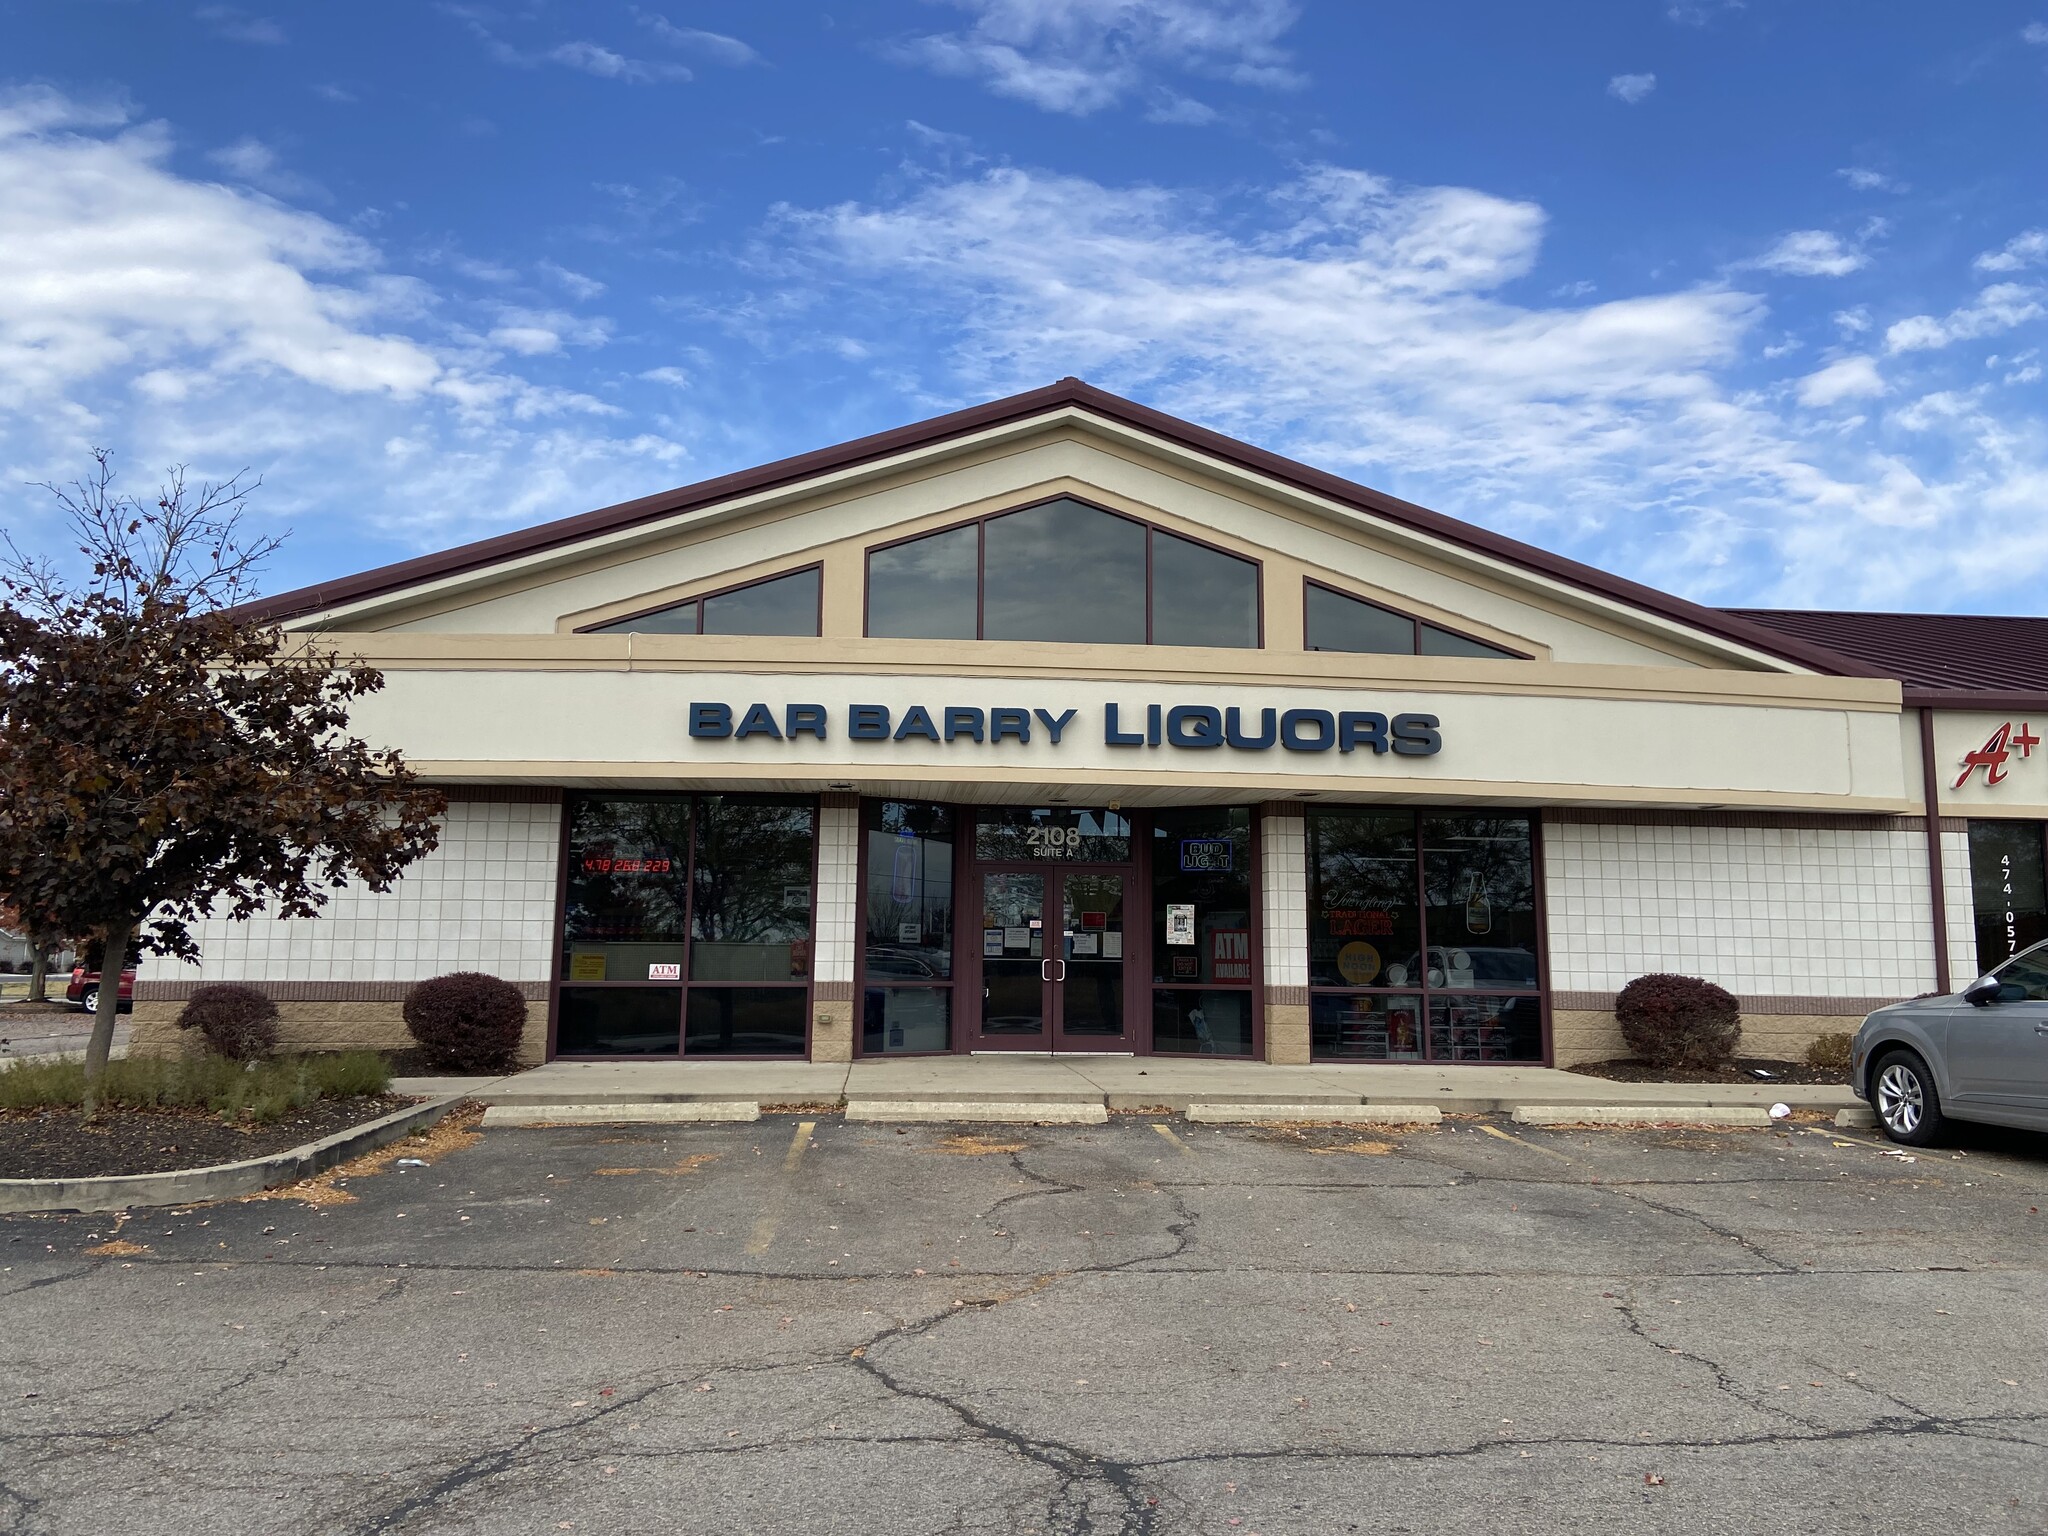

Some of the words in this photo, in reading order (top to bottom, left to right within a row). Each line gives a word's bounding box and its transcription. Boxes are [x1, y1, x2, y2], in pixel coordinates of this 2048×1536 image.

[688, 702, 827, 739] BAR
[848, 703, 1079, 744] BARRY
[1104, 702, 1443, 756] LIQUORS
[1951, 721, 2041, 789] A+
[1026, 826, 1081, 846] 2108
[1033, 848, 1063, 857] SUITE
[1066, 848, 1073, 857] A
[1190, 842, 1224, 855] BUD
[2000, 854, 2017, 958] 474-057
[1329, 919, 1394, 936] LAGER
[1214, 932, 1249, 960] ATM
[1344, 952, 1374, 962] HIGH
[652, 965, 677, 975] ATM
[1215, 963, 1250, 979] AVAILABLE
[1343, 962, 1376, 971] NOON
